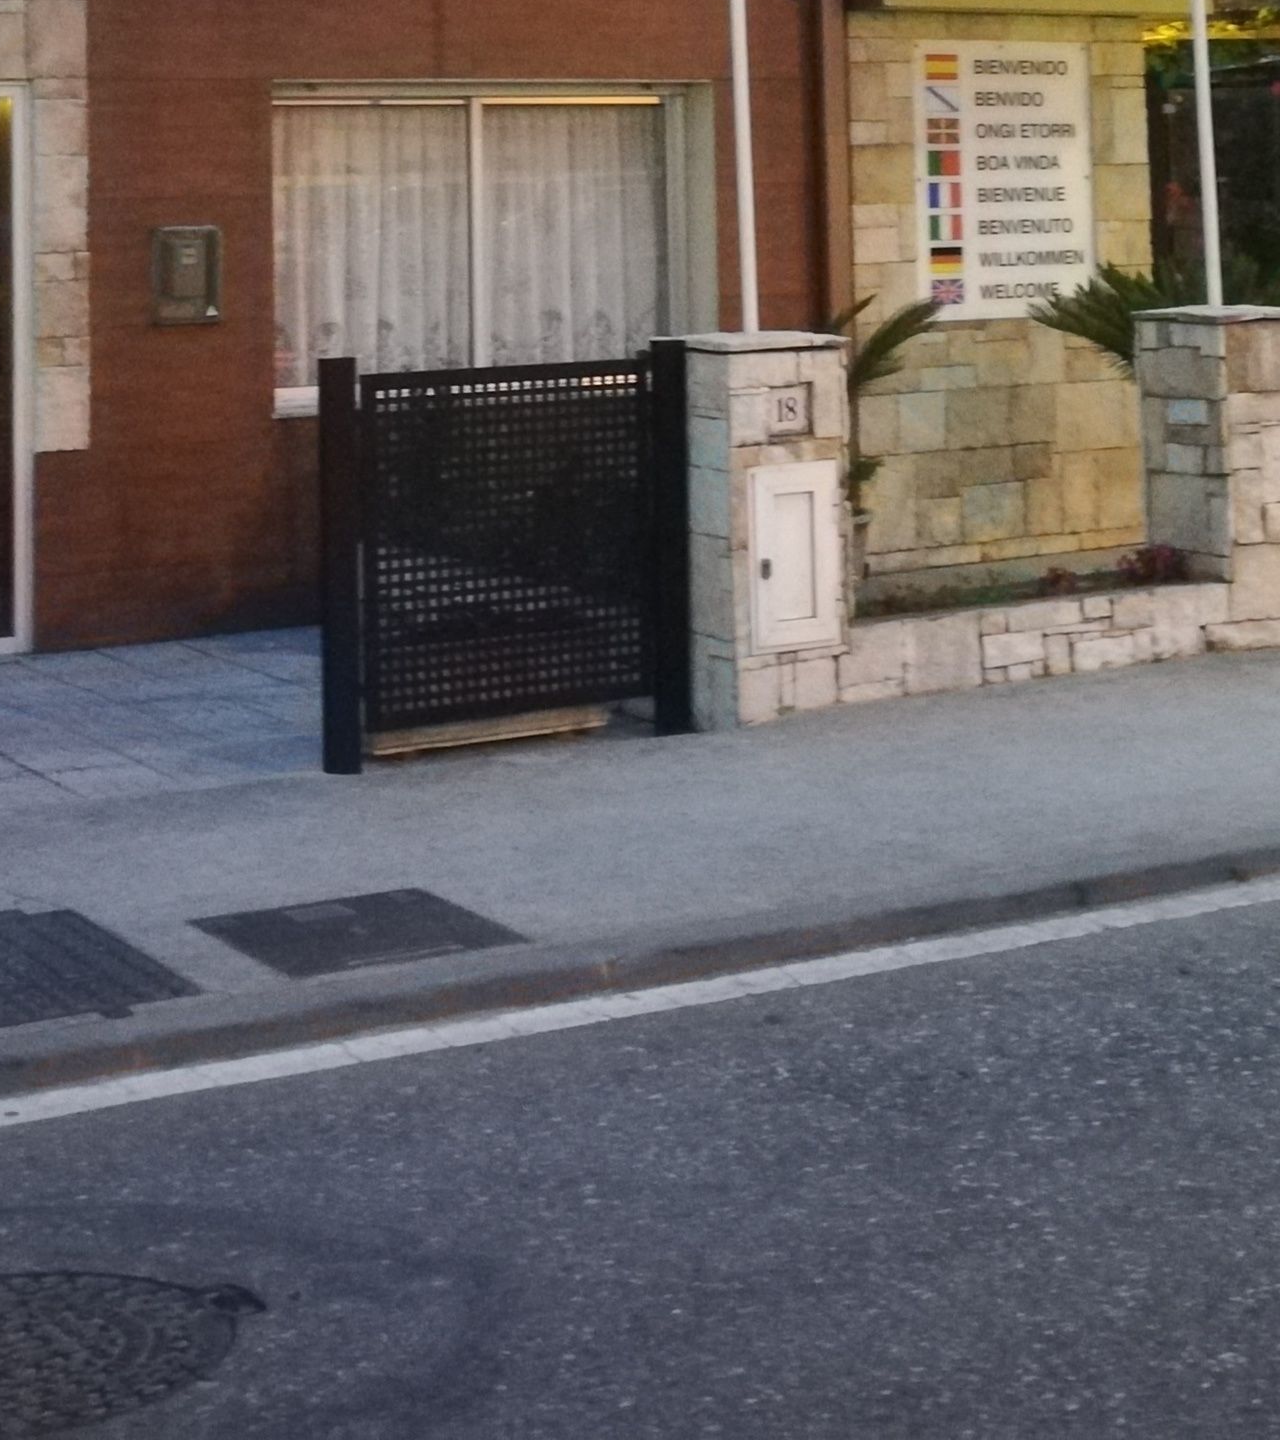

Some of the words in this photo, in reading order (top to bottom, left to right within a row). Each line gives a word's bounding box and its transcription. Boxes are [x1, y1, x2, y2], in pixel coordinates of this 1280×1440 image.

[973, 59, 1068, 76] BIENVENIDO
[974, 91, 1044, 107] BENVIDO
[975, 123, 1015, 138] ONGI
[1020, 123, 1076, 138] ETORRI
[976, 155, 1010, 171] BOA
[1014, 155, 1061, 170] VINDA
[977, 186, 1067, 203] BIENVENUE
[978, 218, 1073, 235] BENVENUTO
[979, 250, 1085, 267] WILLKOMMEN
[980, 282, 1060, 299] WELCOME
[776, 396, 798, 423] 18
